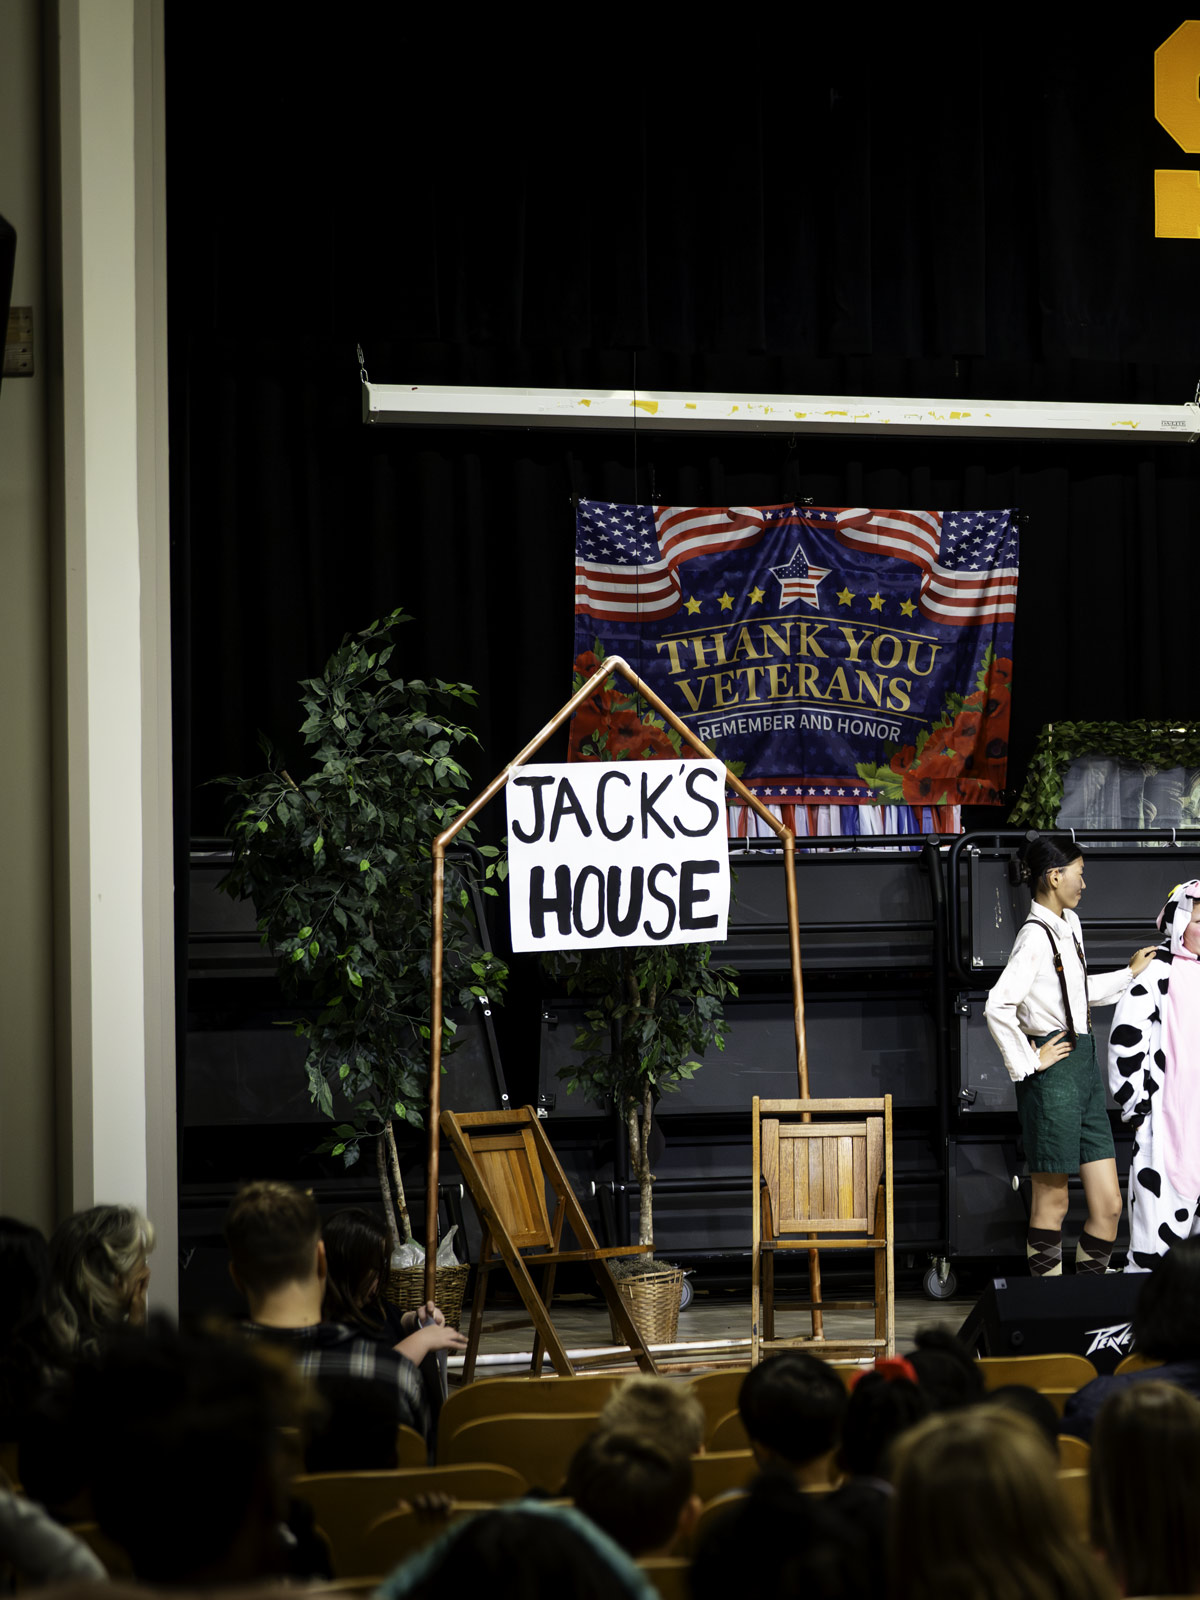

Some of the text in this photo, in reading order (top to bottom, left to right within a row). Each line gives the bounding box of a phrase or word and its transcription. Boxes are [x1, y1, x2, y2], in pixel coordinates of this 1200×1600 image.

[656, 622, 943, 677] THANK YOU
[674, 663, 913, 712] VETERANS
[698, 714, 901, 742] REMEMBER AND HONOR
[511, 763, 720, 844] JACK'S
[529, 860, 721, 941] HOUSE
